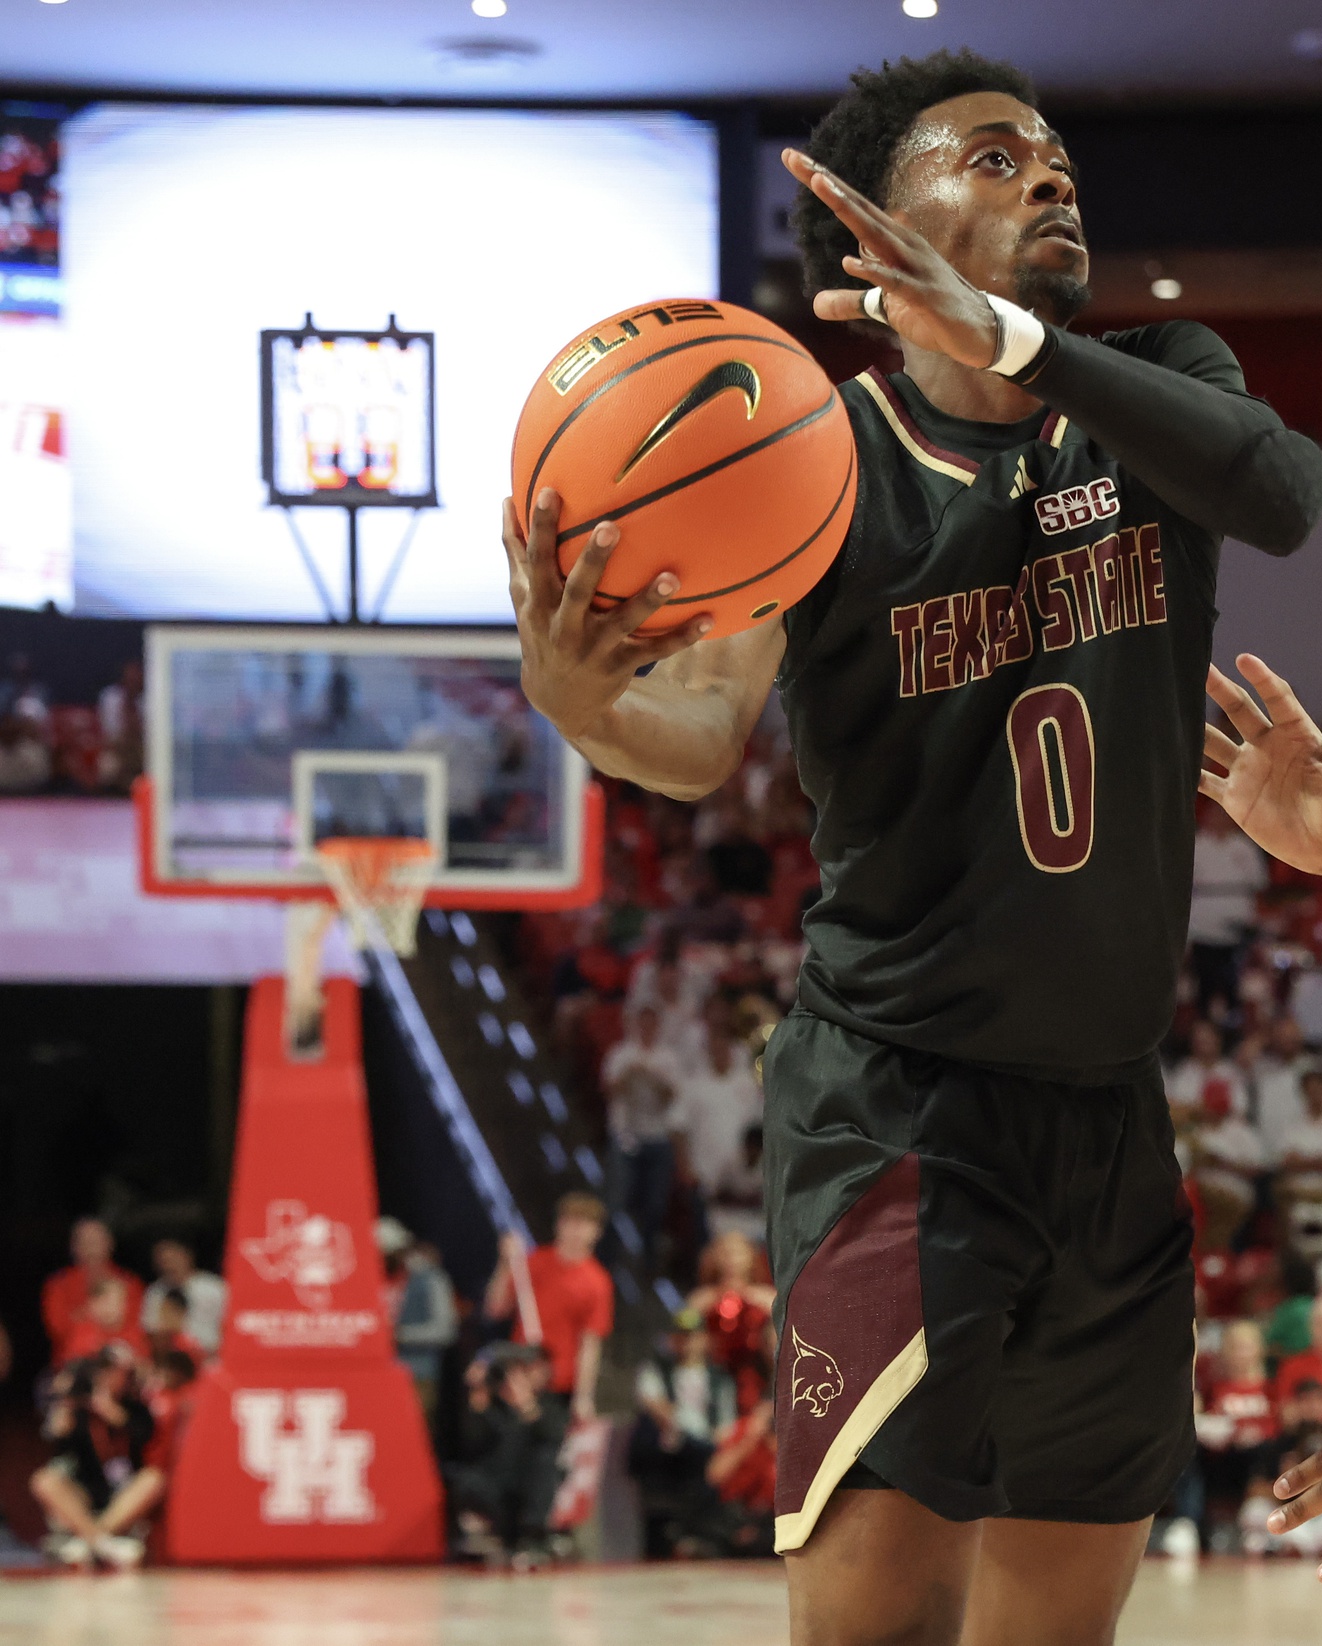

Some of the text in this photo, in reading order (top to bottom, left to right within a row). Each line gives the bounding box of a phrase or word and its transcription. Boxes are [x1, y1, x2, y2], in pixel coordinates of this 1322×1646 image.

[546, 302, 725, 397] ELITE
[1034, 477, 1121, 535] SBC
[891, 522, 1168, 698] TEXAS STATE
[1006, 682, 1095, 873] 0
